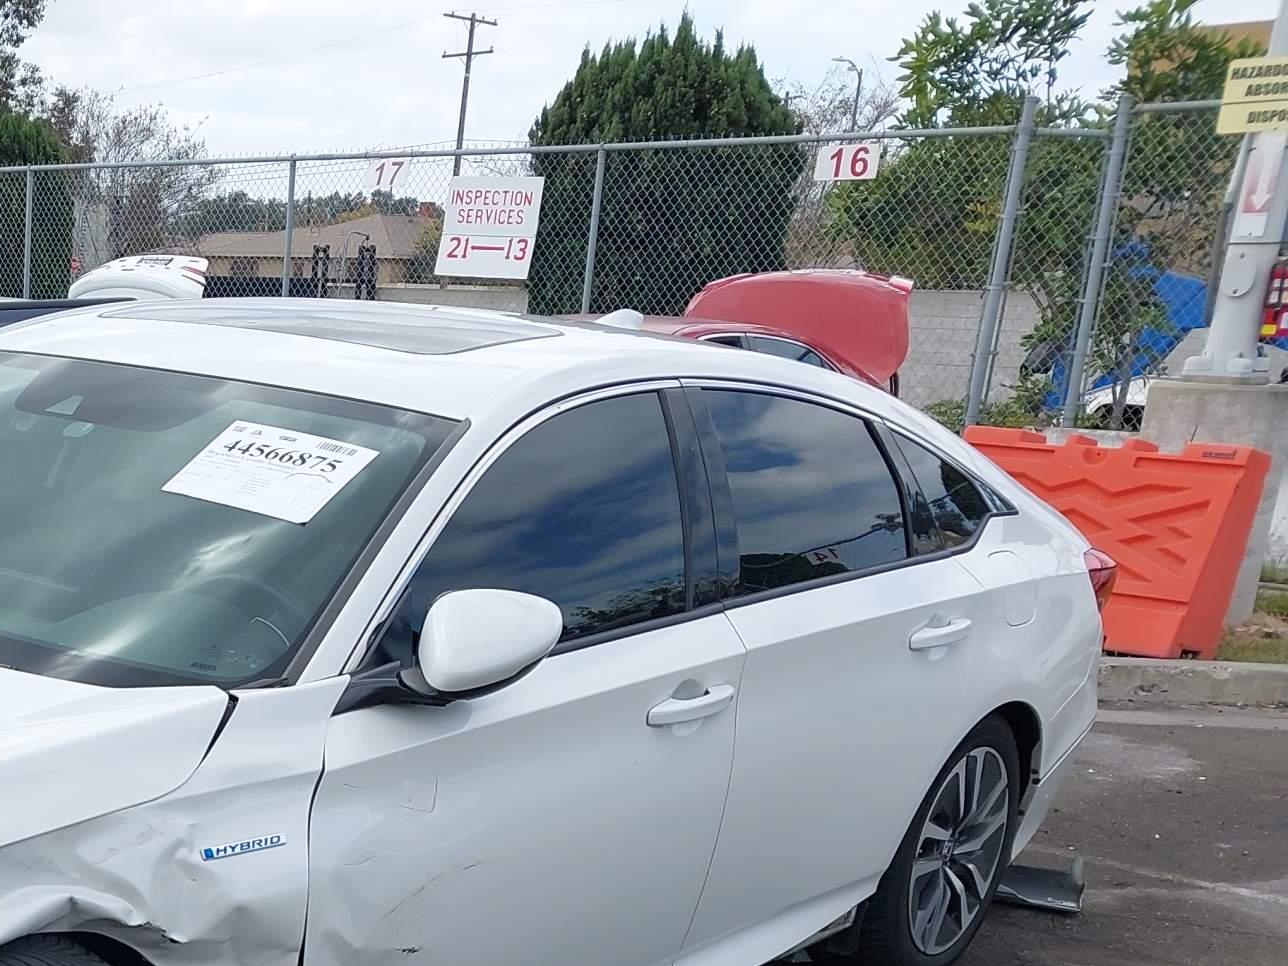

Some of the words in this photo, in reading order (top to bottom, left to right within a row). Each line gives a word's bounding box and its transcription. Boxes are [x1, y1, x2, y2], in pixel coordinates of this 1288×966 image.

[375, 161, 405, 186] 17
[830, 146, 871, 178] 16
[451, 190, 533, 207] INSPECTION
[457, 209, 524, 225] SERVICES
[223, 439, 343, 473] 44566875
[215, 834, 281, 857] HYBRID
